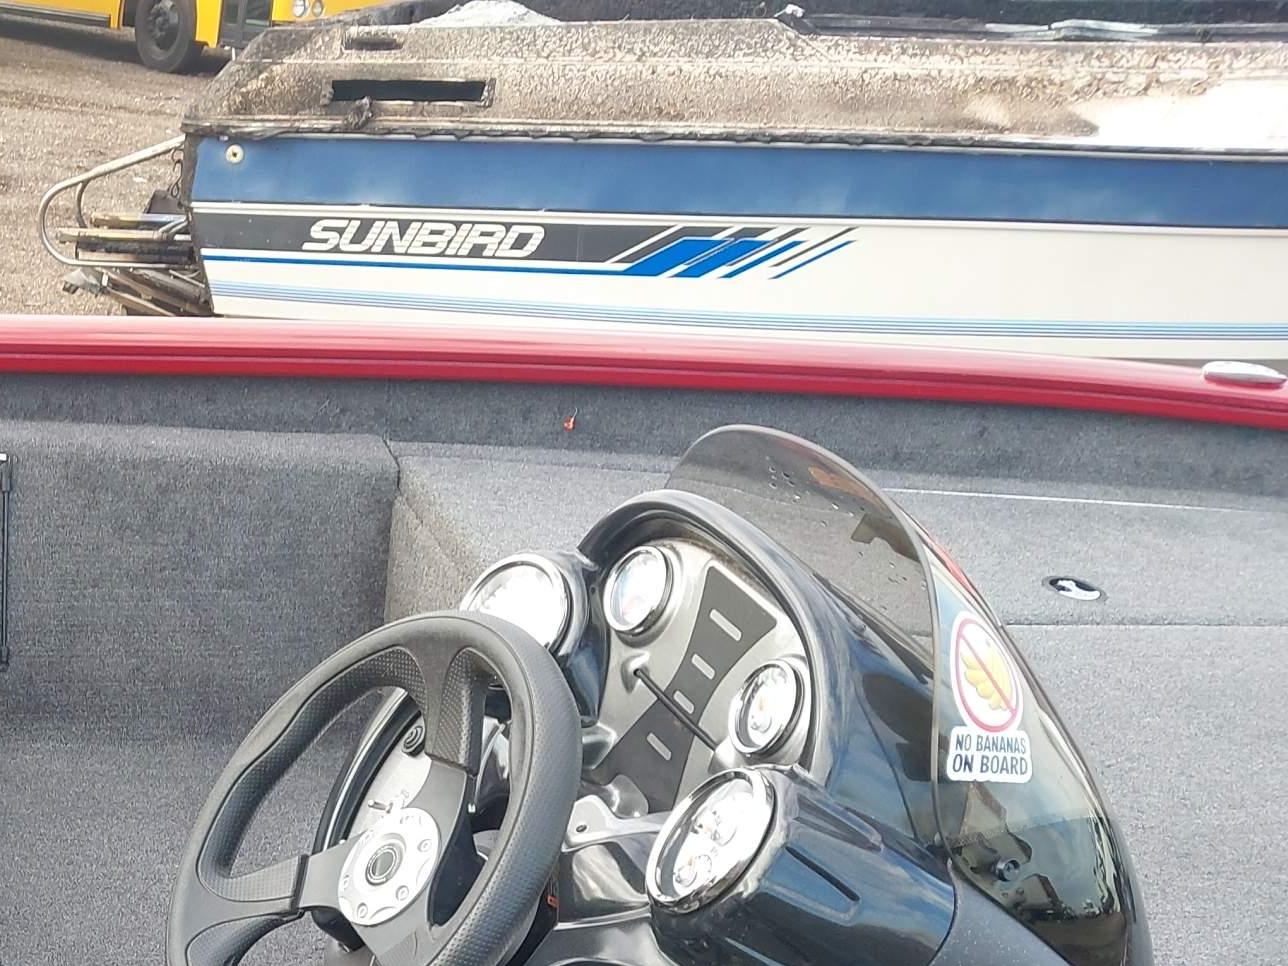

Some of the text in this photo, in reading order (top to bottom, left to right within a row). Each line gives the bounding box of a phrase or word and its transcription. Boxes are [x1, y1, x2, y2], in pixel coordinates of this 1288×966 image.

[302, 218, 545, 258] SUNBIRD
[955, 733, 1027, 754] NO BANANAS
[952, 753, 1028, 776] ON BOARD
